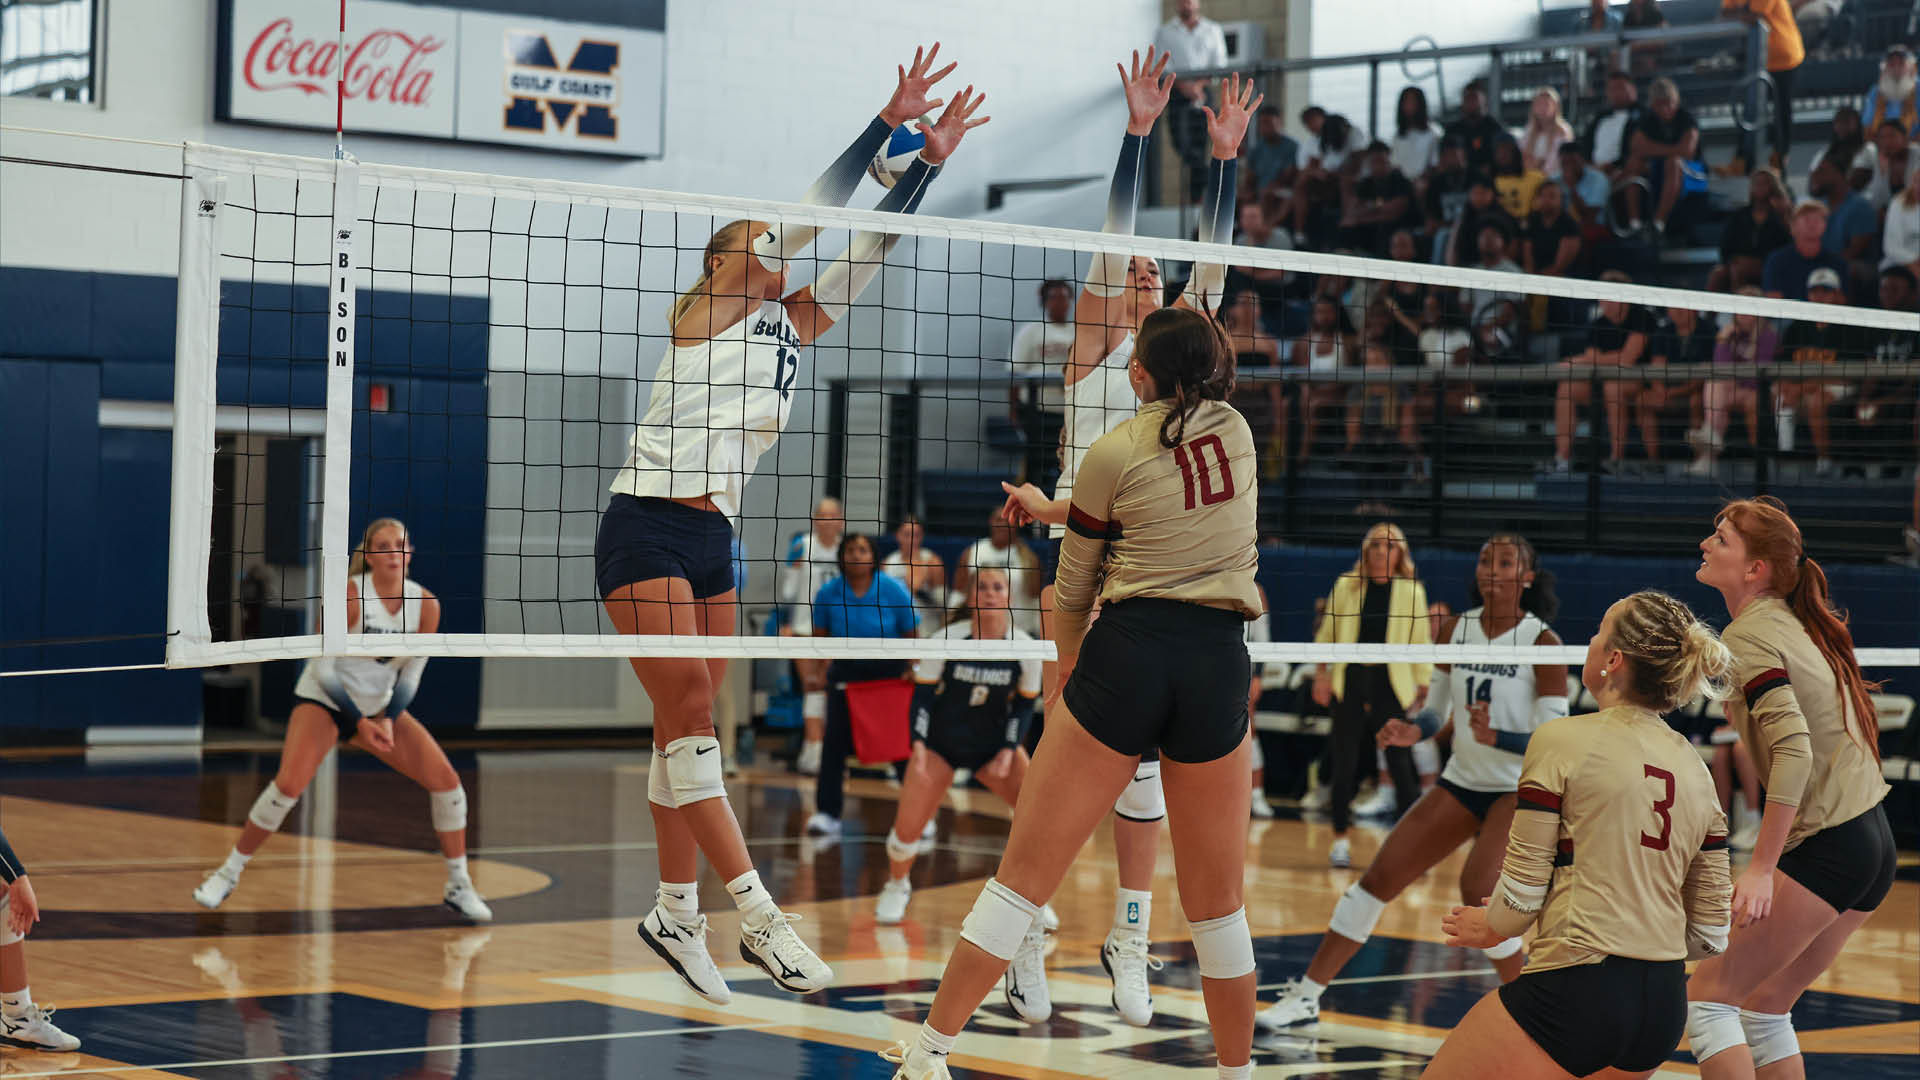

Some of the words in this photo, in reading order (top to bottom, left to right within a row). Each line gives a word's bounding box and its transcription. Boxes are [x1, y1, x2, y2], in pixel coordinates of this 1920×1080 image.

[511, 74, 553, 94] GULF
[559, 79, 613, 99] COAST
[335, 252, 349, 367] BISON
[774, 347, 797, 402] 12
[1174, 433, 1235, 510] 10
[953, 664, 1012, 686] BULLDOGS
[1454, 663, 1518, 678] LDOGS
[1466, 676, 1492, 705] 14
[1640, 763, 1675, 852] 3
